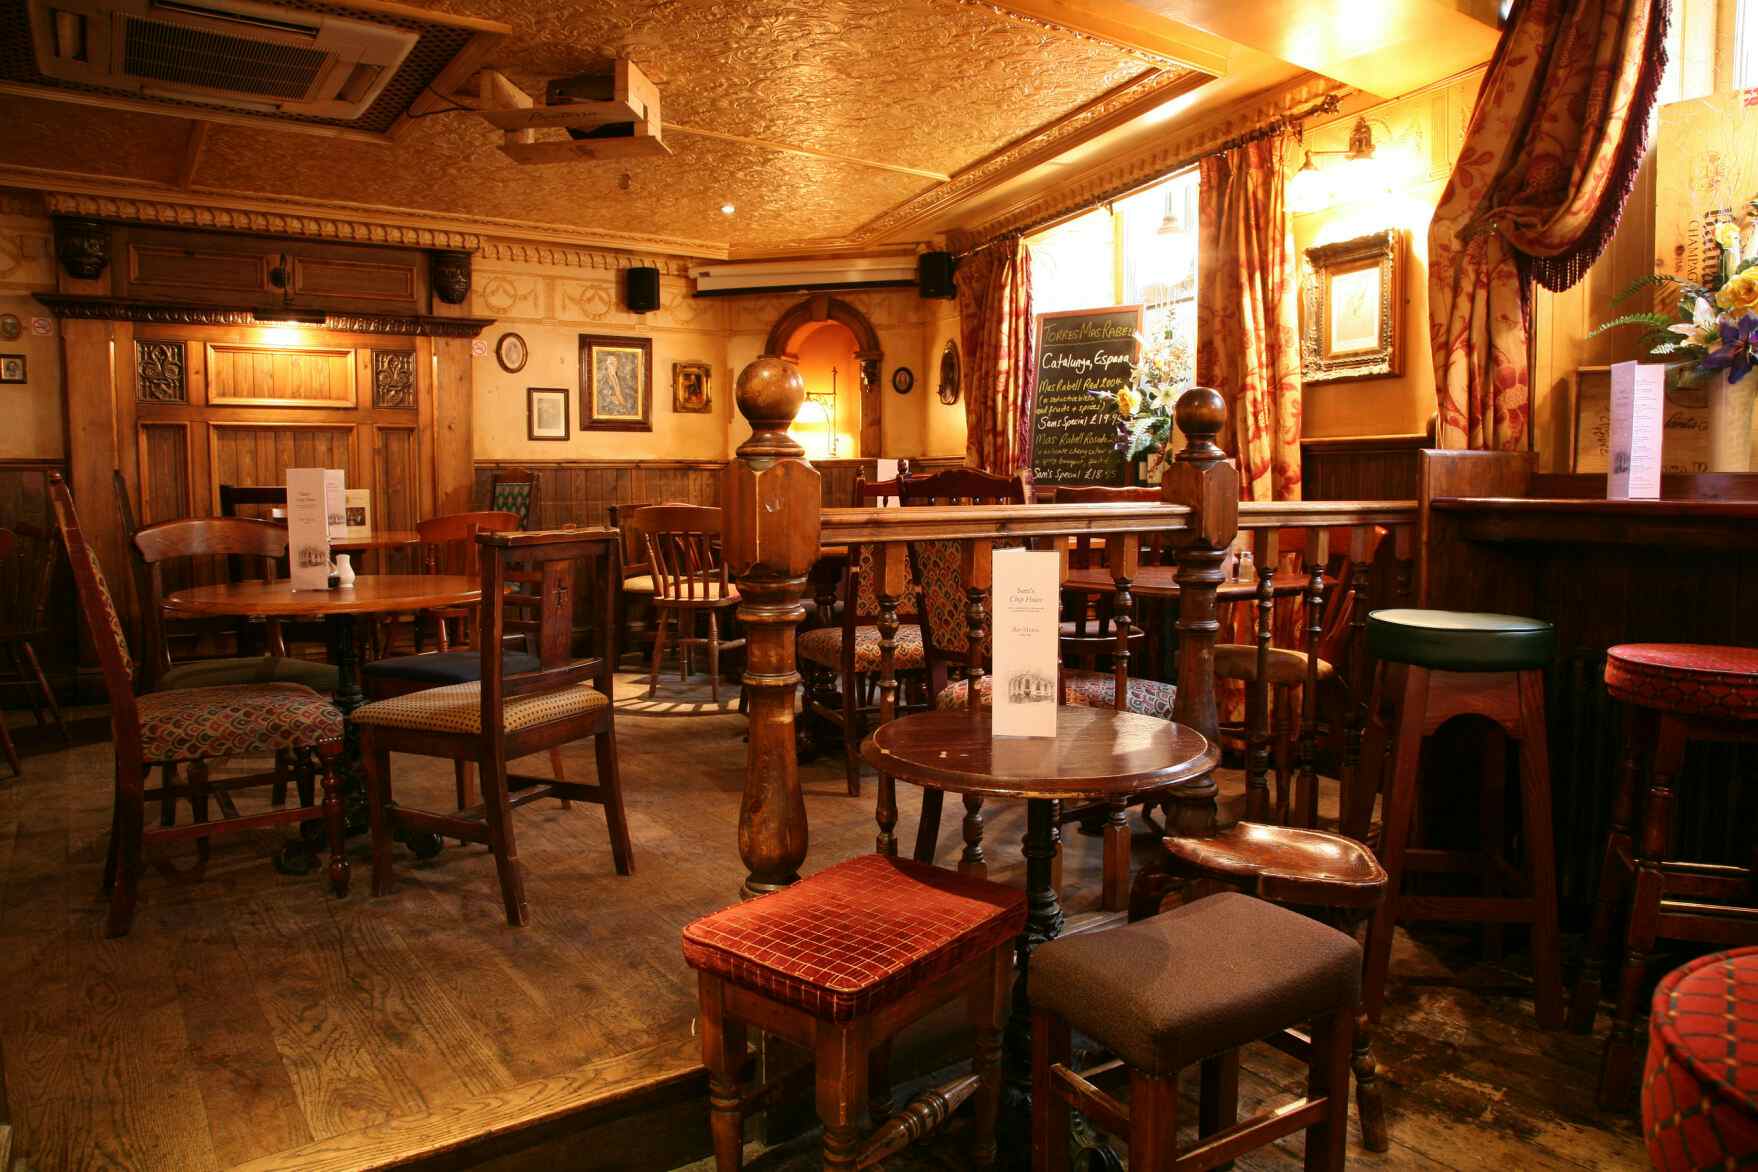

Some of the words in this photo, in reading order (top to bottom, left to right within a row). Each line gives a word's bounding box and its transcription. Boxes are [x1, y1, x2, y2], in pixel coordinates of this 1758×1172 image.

[1687, 219, 1698, 281] CHAMPAG
[1042, 353, 1093, 374] Catalunya,
[1055, 468, 1080, 481] Special
